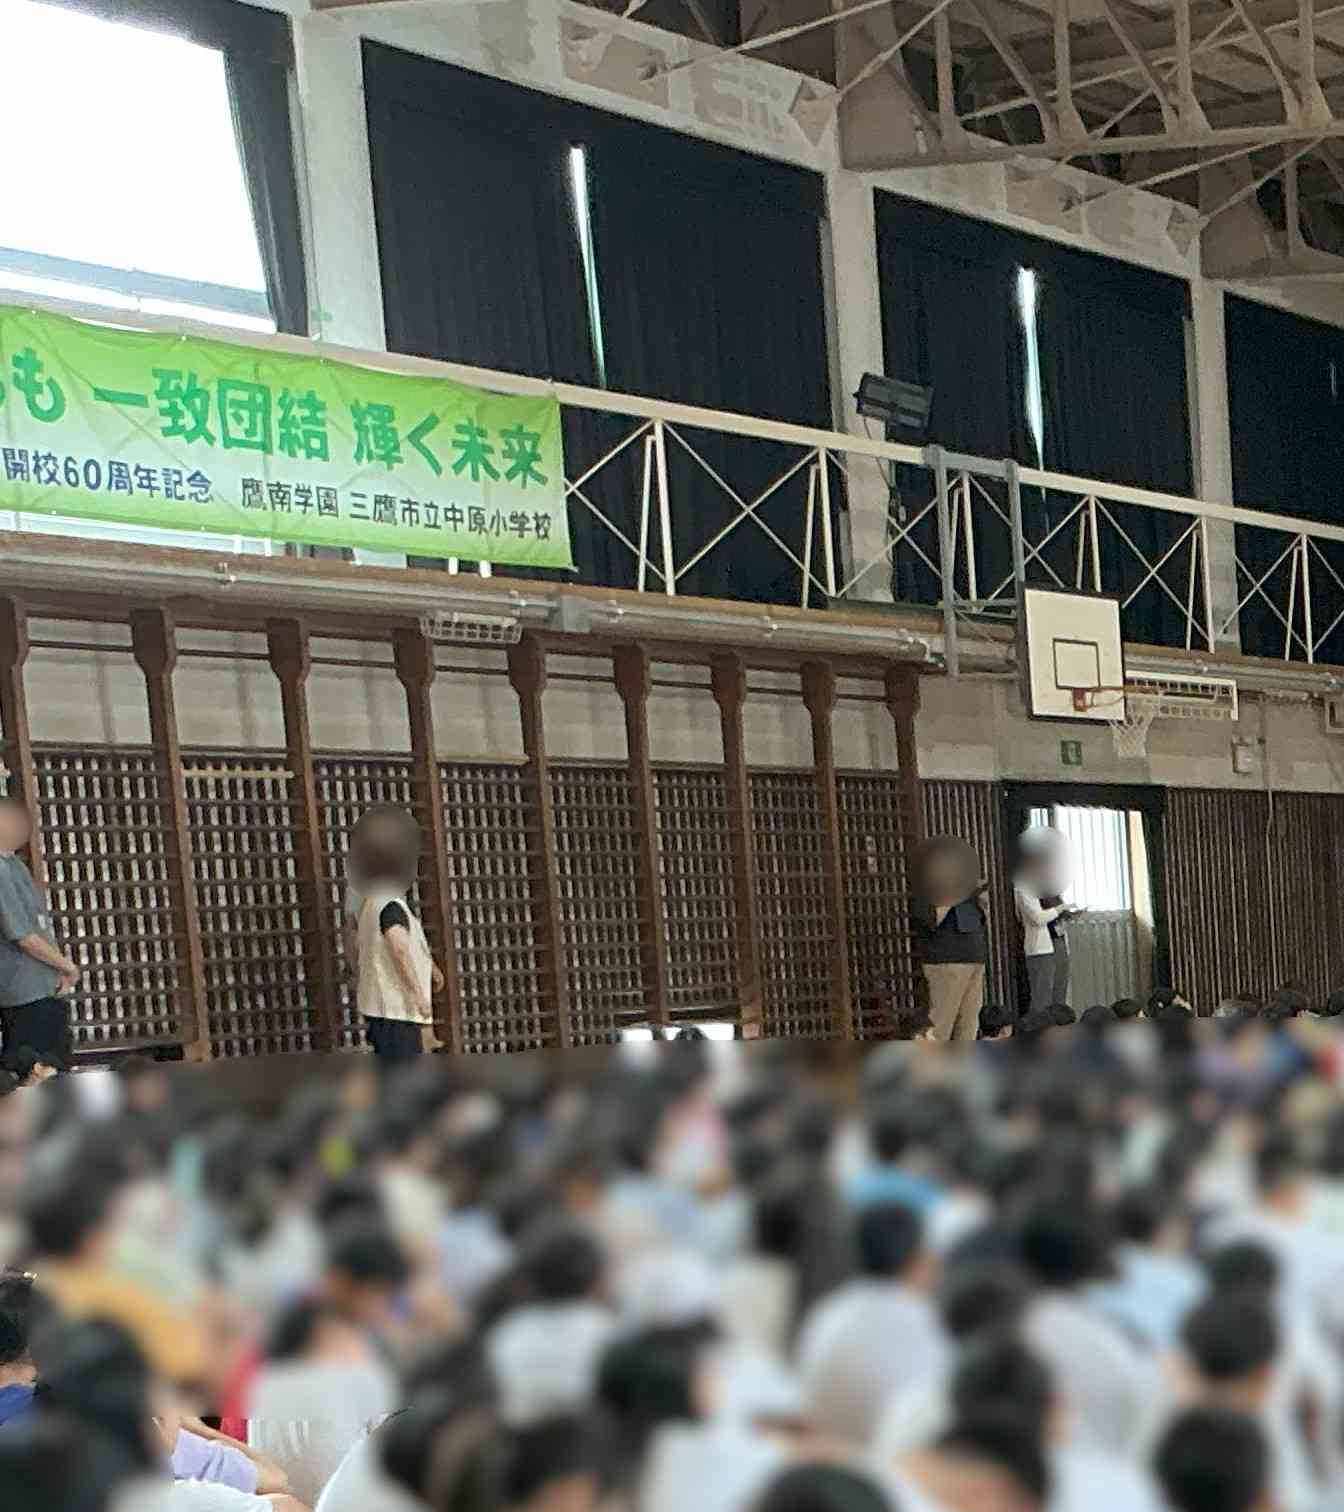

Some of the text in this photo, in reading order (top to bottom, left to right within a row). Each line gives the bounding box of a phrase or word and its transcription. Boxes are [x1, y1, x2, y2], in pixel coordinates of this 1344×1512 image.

[92, 368, 329, 463] 一致団結
[349, 398, 549, 489] 輝く未来
[1, 447, 550, 540] 開校60周年記念 鷹南学園 三鷹市立中原小学校
